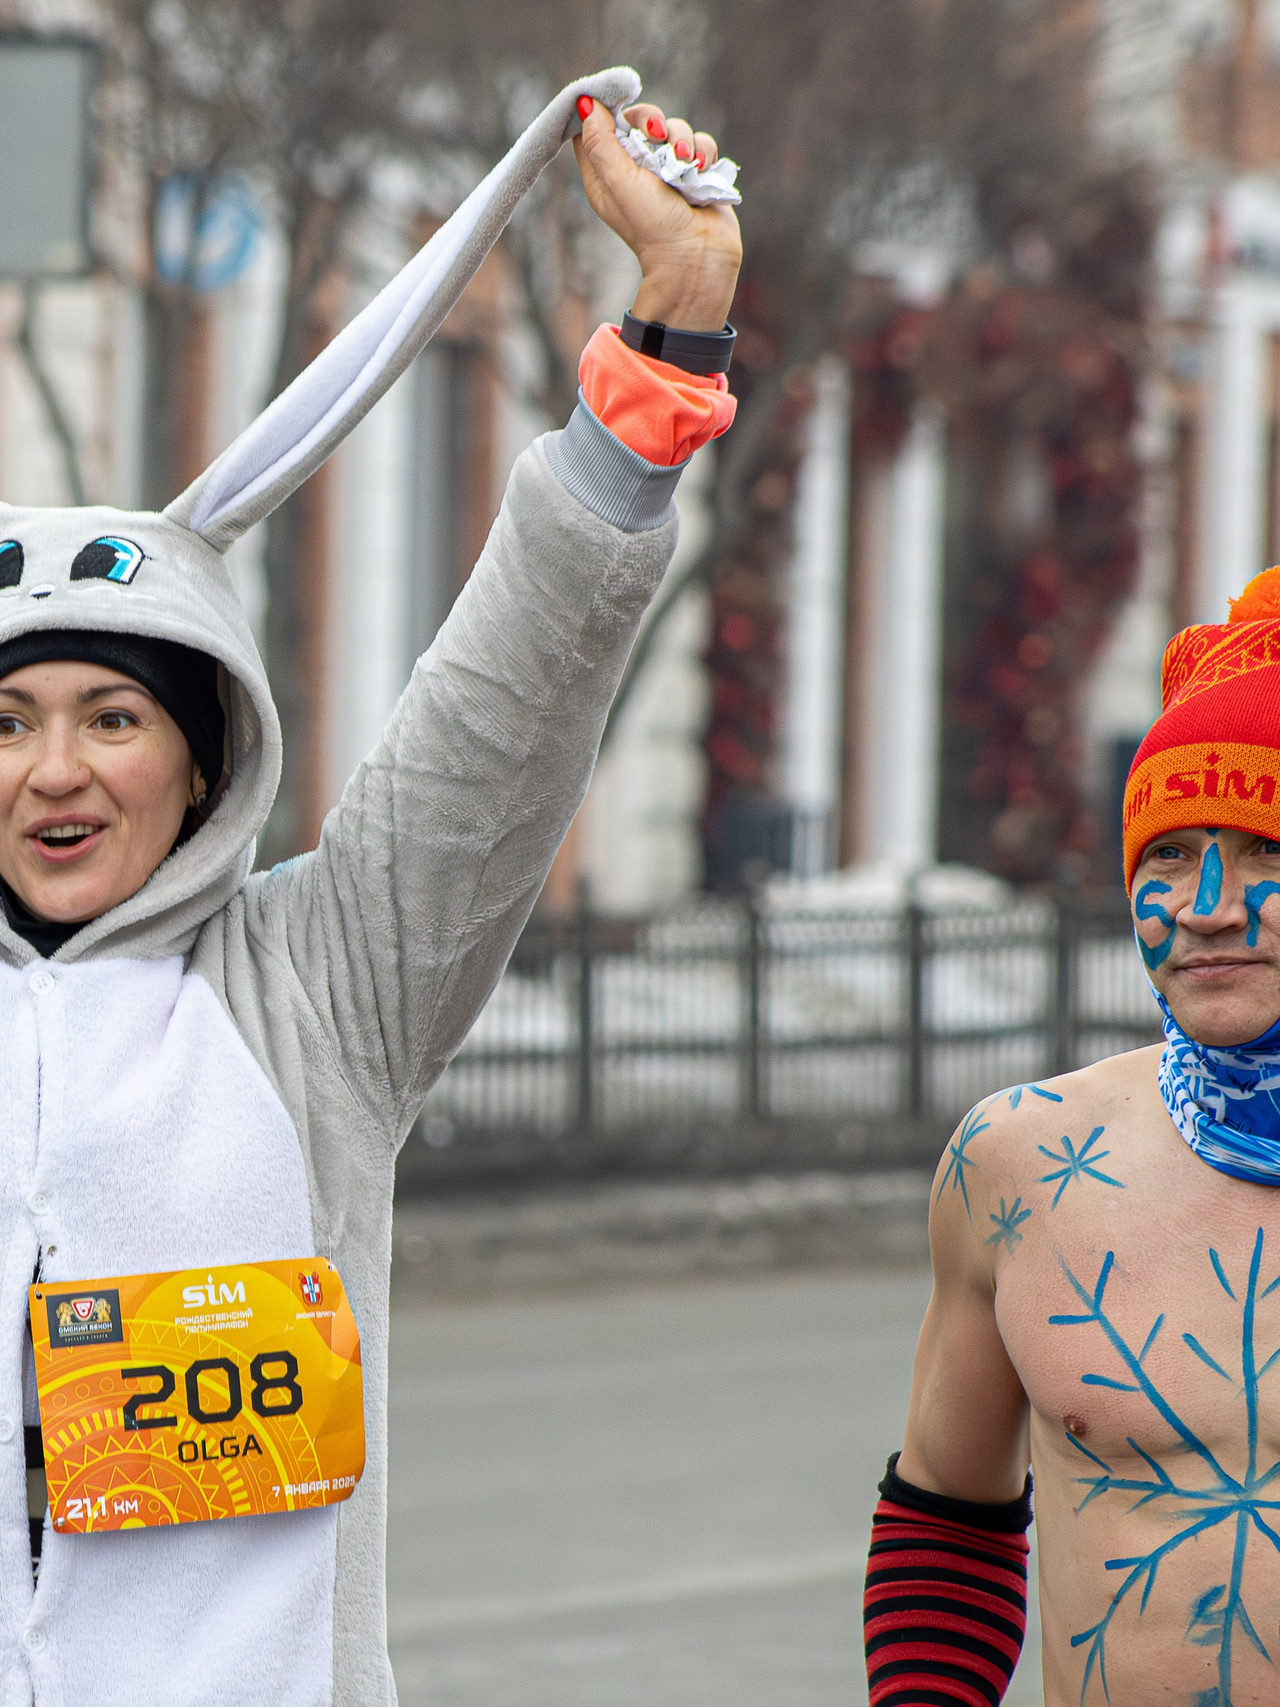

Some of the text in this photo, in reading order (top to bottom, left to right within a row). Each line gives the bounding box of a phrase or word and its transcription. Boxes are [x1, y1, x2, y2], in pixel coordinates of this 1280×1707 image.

[174, 1308, 253, 1326] РОЖДЕСТВЕНСКИЙ
[184, 1320, 249, 1334] ПОЛУМАРАФОН
[121, 1350, 304, 1432] 208
[177, 1434, 263, 1463] OLGA
[272, 1485, 281, 1498] 7
[284, 1479, 330, 1496] ЯНВАРЯ
[66, 1496, 107, 1520] 21,1
